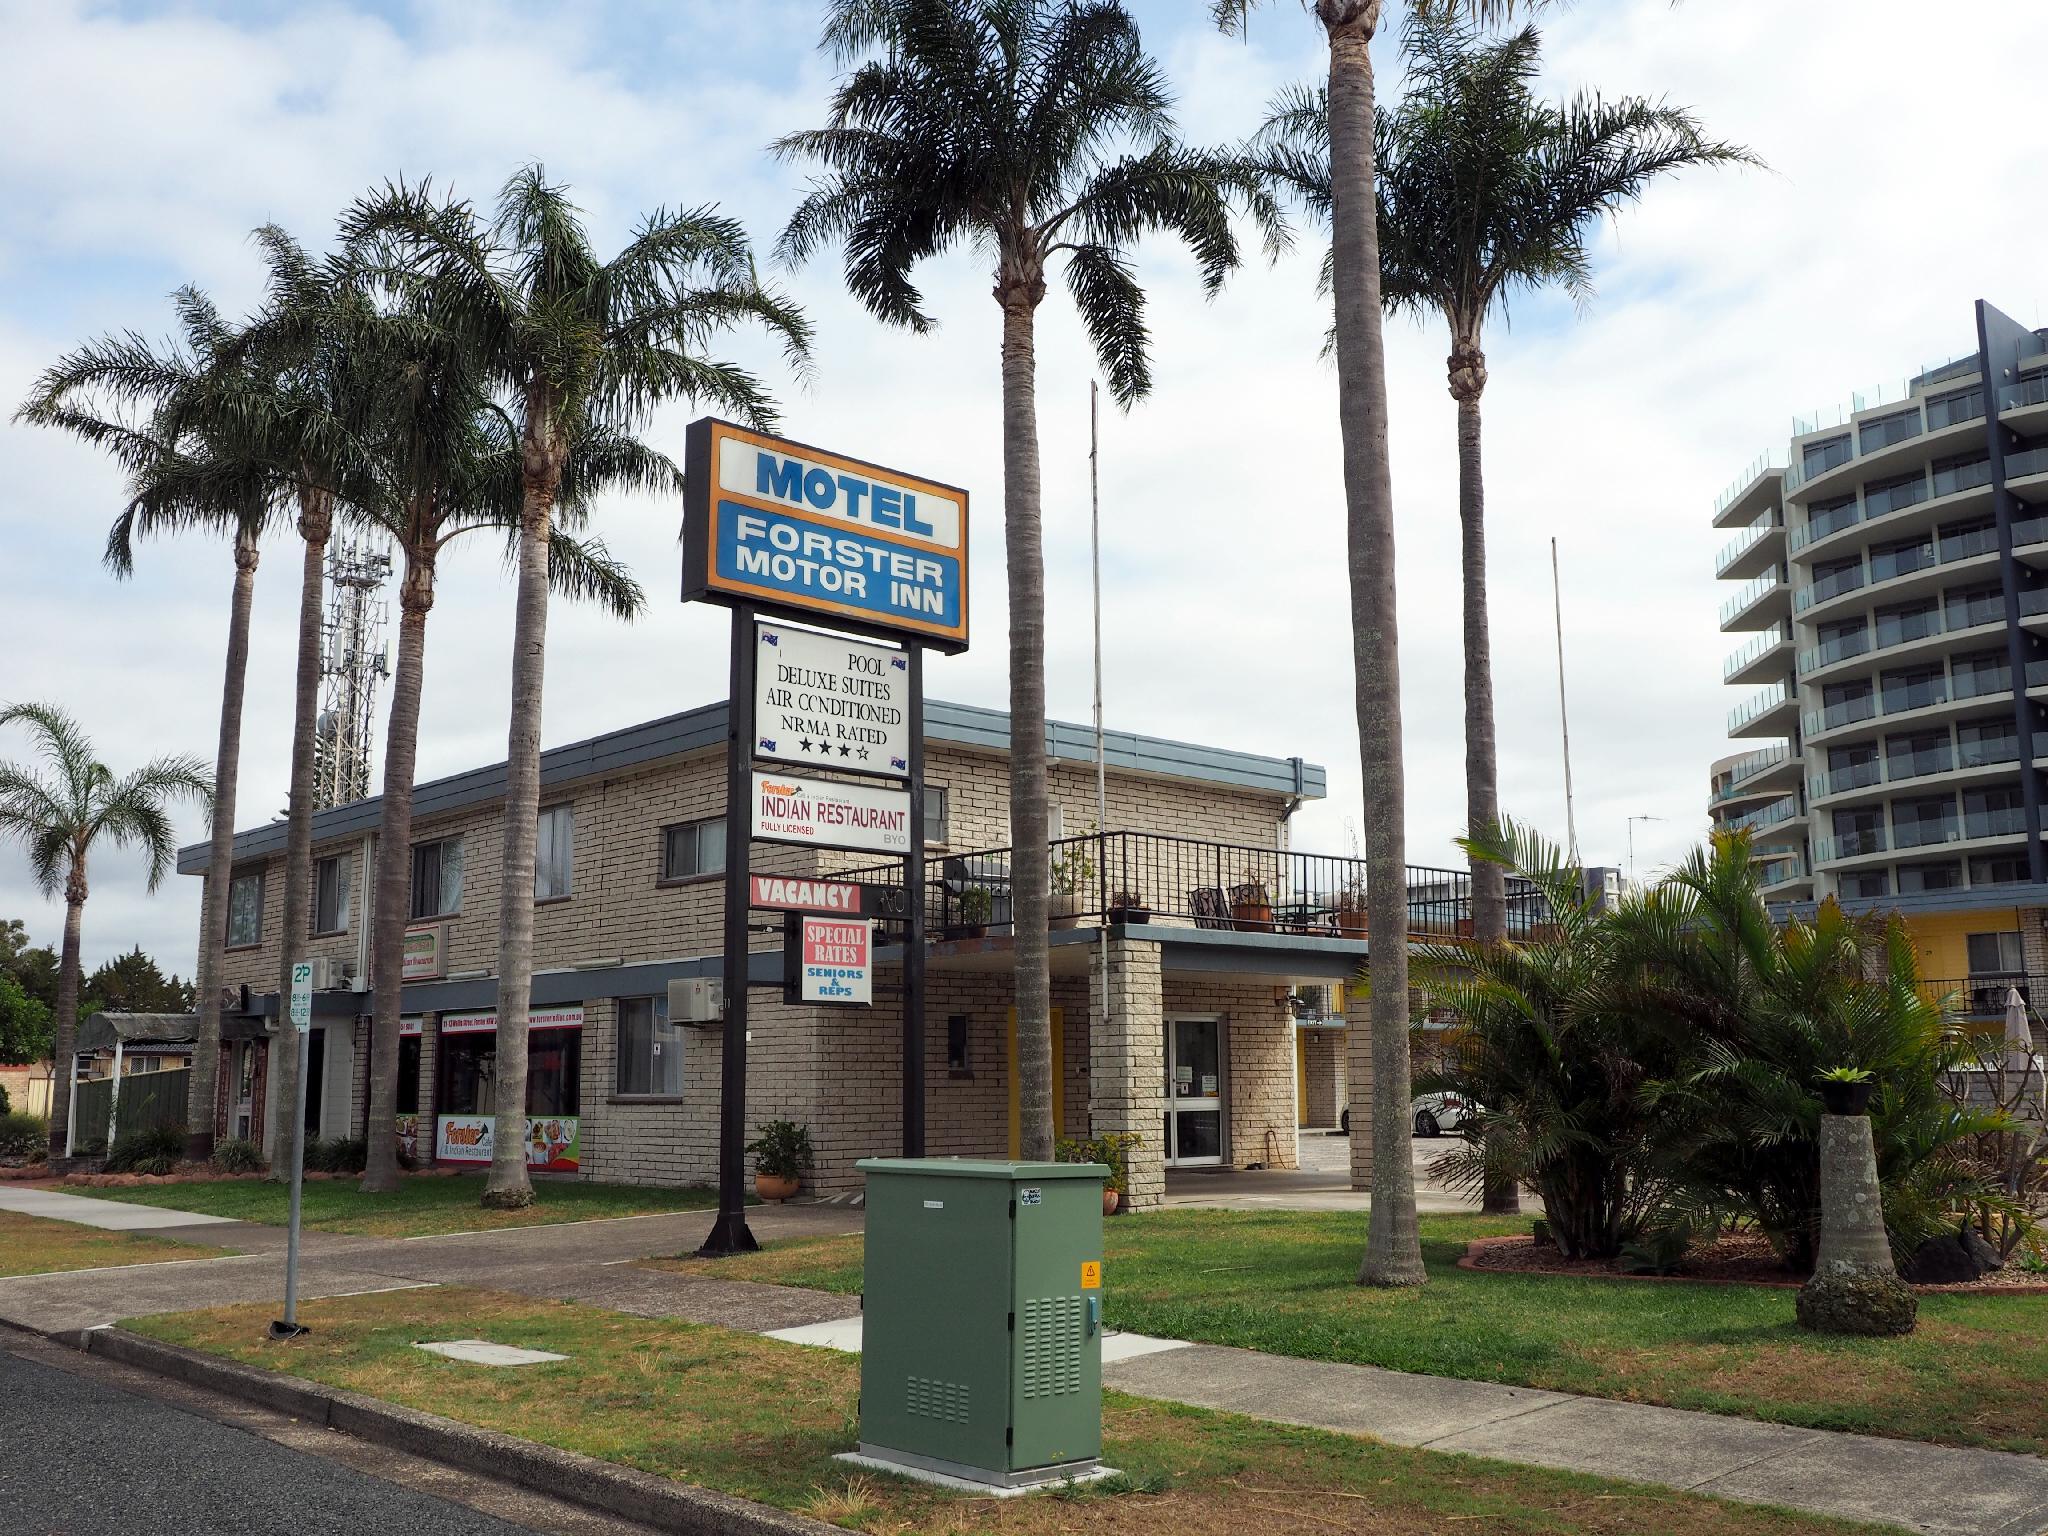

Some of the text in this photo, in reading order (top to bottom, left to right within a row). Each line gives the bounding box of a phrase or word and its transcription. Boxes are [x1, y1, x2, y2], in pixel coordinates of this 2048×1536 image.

[757, 452, 933, 537] MOTEL
[736, 514, 943, 588] FORSTER
[735, 545, 944, 616] MOTOR INN
[848, 653, 886, 677] POOL
[777, 664, 891, 701] DELUXE SUITES
[766, 687, 793, 709] AIR
[781, 715, 887, 745] NRMA RATED
[761, 795, 905, 832] INDIAN RESTAURANT
[761, 821, 815, 836] FULLY LICENSED
[884, 833, 906, 845] BYO
[757, 878, 853, 909] VACANCY
[807, 925, 864, 945] SPECIAL
[814, 944, 857, 963] RATES
[294, 966, 311, 983] 2P
[807, 967, 863, 979] SENIORS
[831, 978, 840, 987] &
[818, 986, 852, 996] REPS
